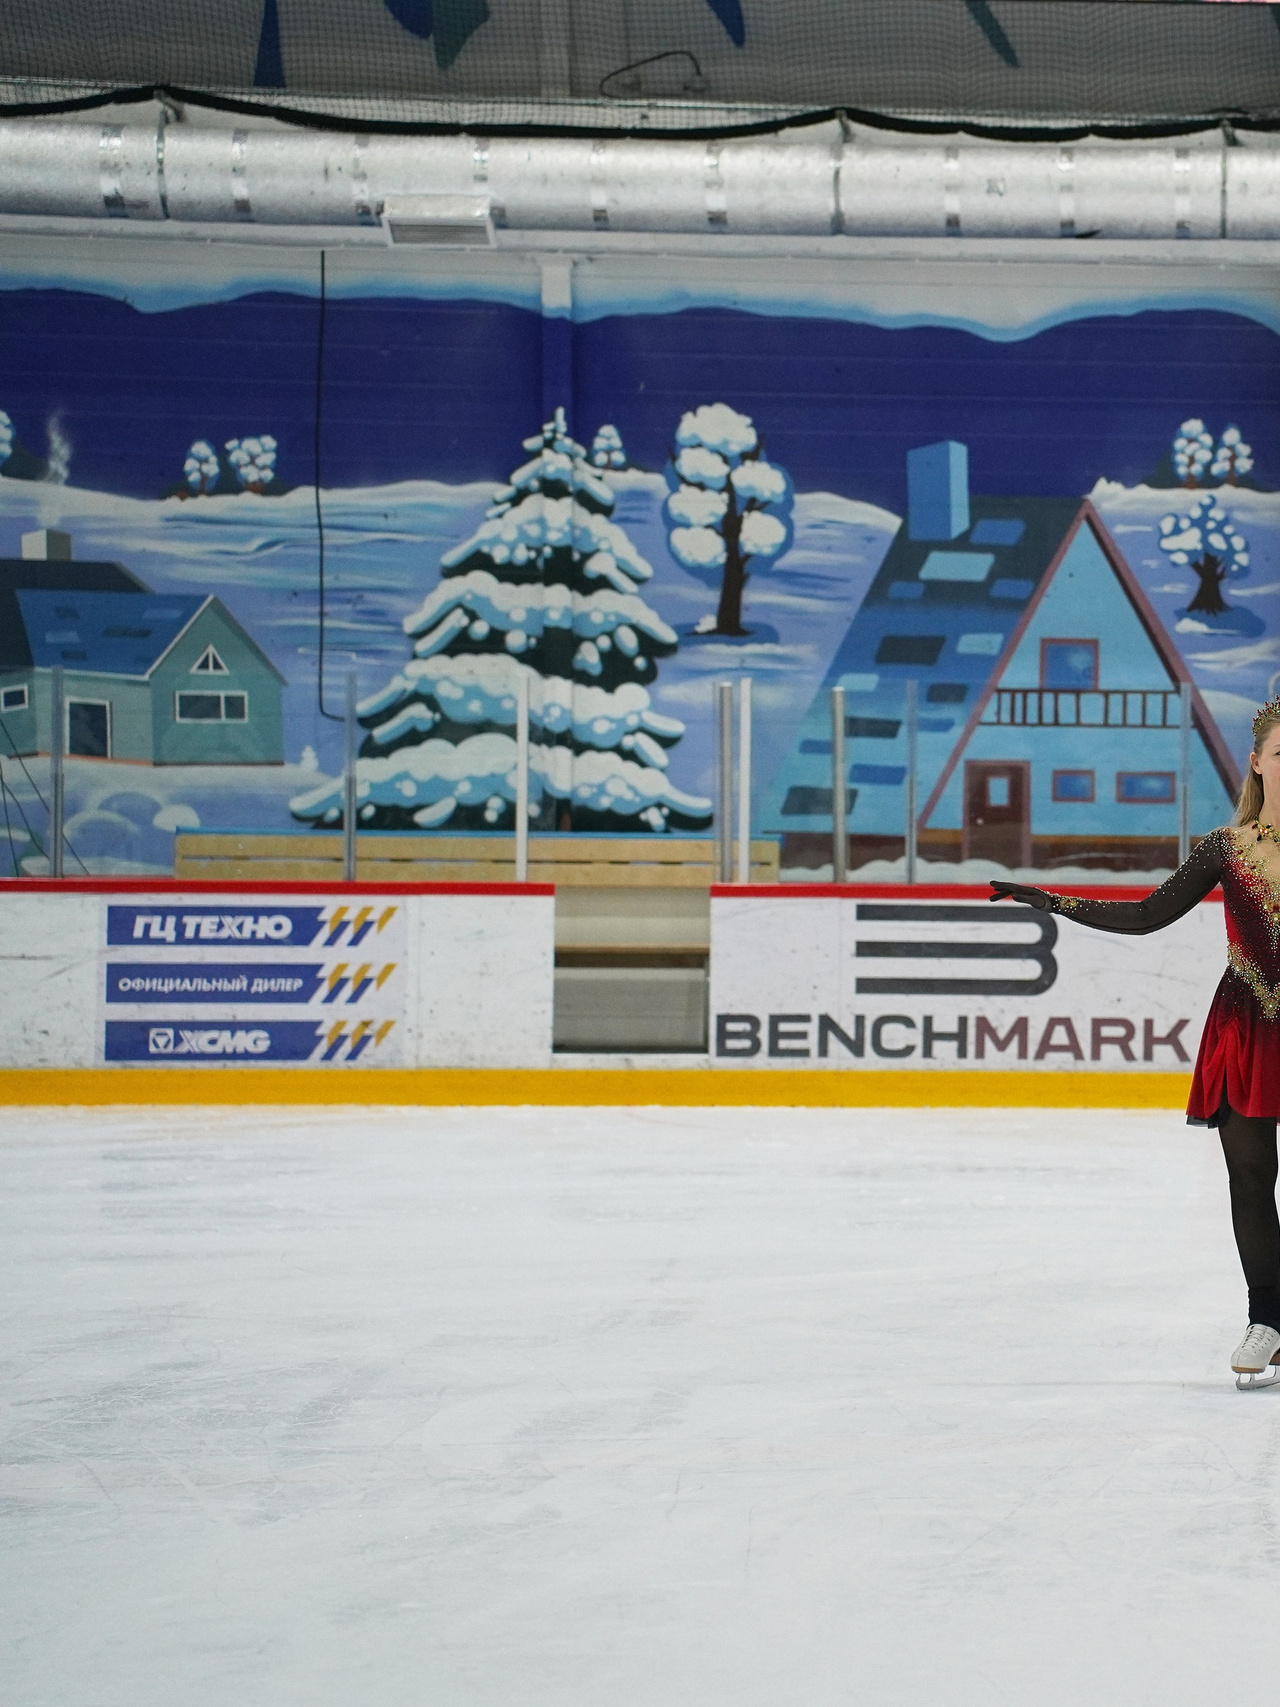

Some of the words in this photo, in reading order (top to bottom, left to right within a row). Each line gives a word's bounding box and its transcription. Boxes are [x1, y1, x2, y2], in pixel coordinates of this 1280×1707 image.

[133, 915, 176, 942] ГЦ
[182, 914, 293, 940] ТЕХНО
[118, 974, 248, 993] ОФИЦИАЛЬНЫЙ
[251, 978, 303, 994] ДИЛЕР
[177, 1029, 271, 1054] XCMG
[715, 1013, 1192, 1063] BENCHMARK
